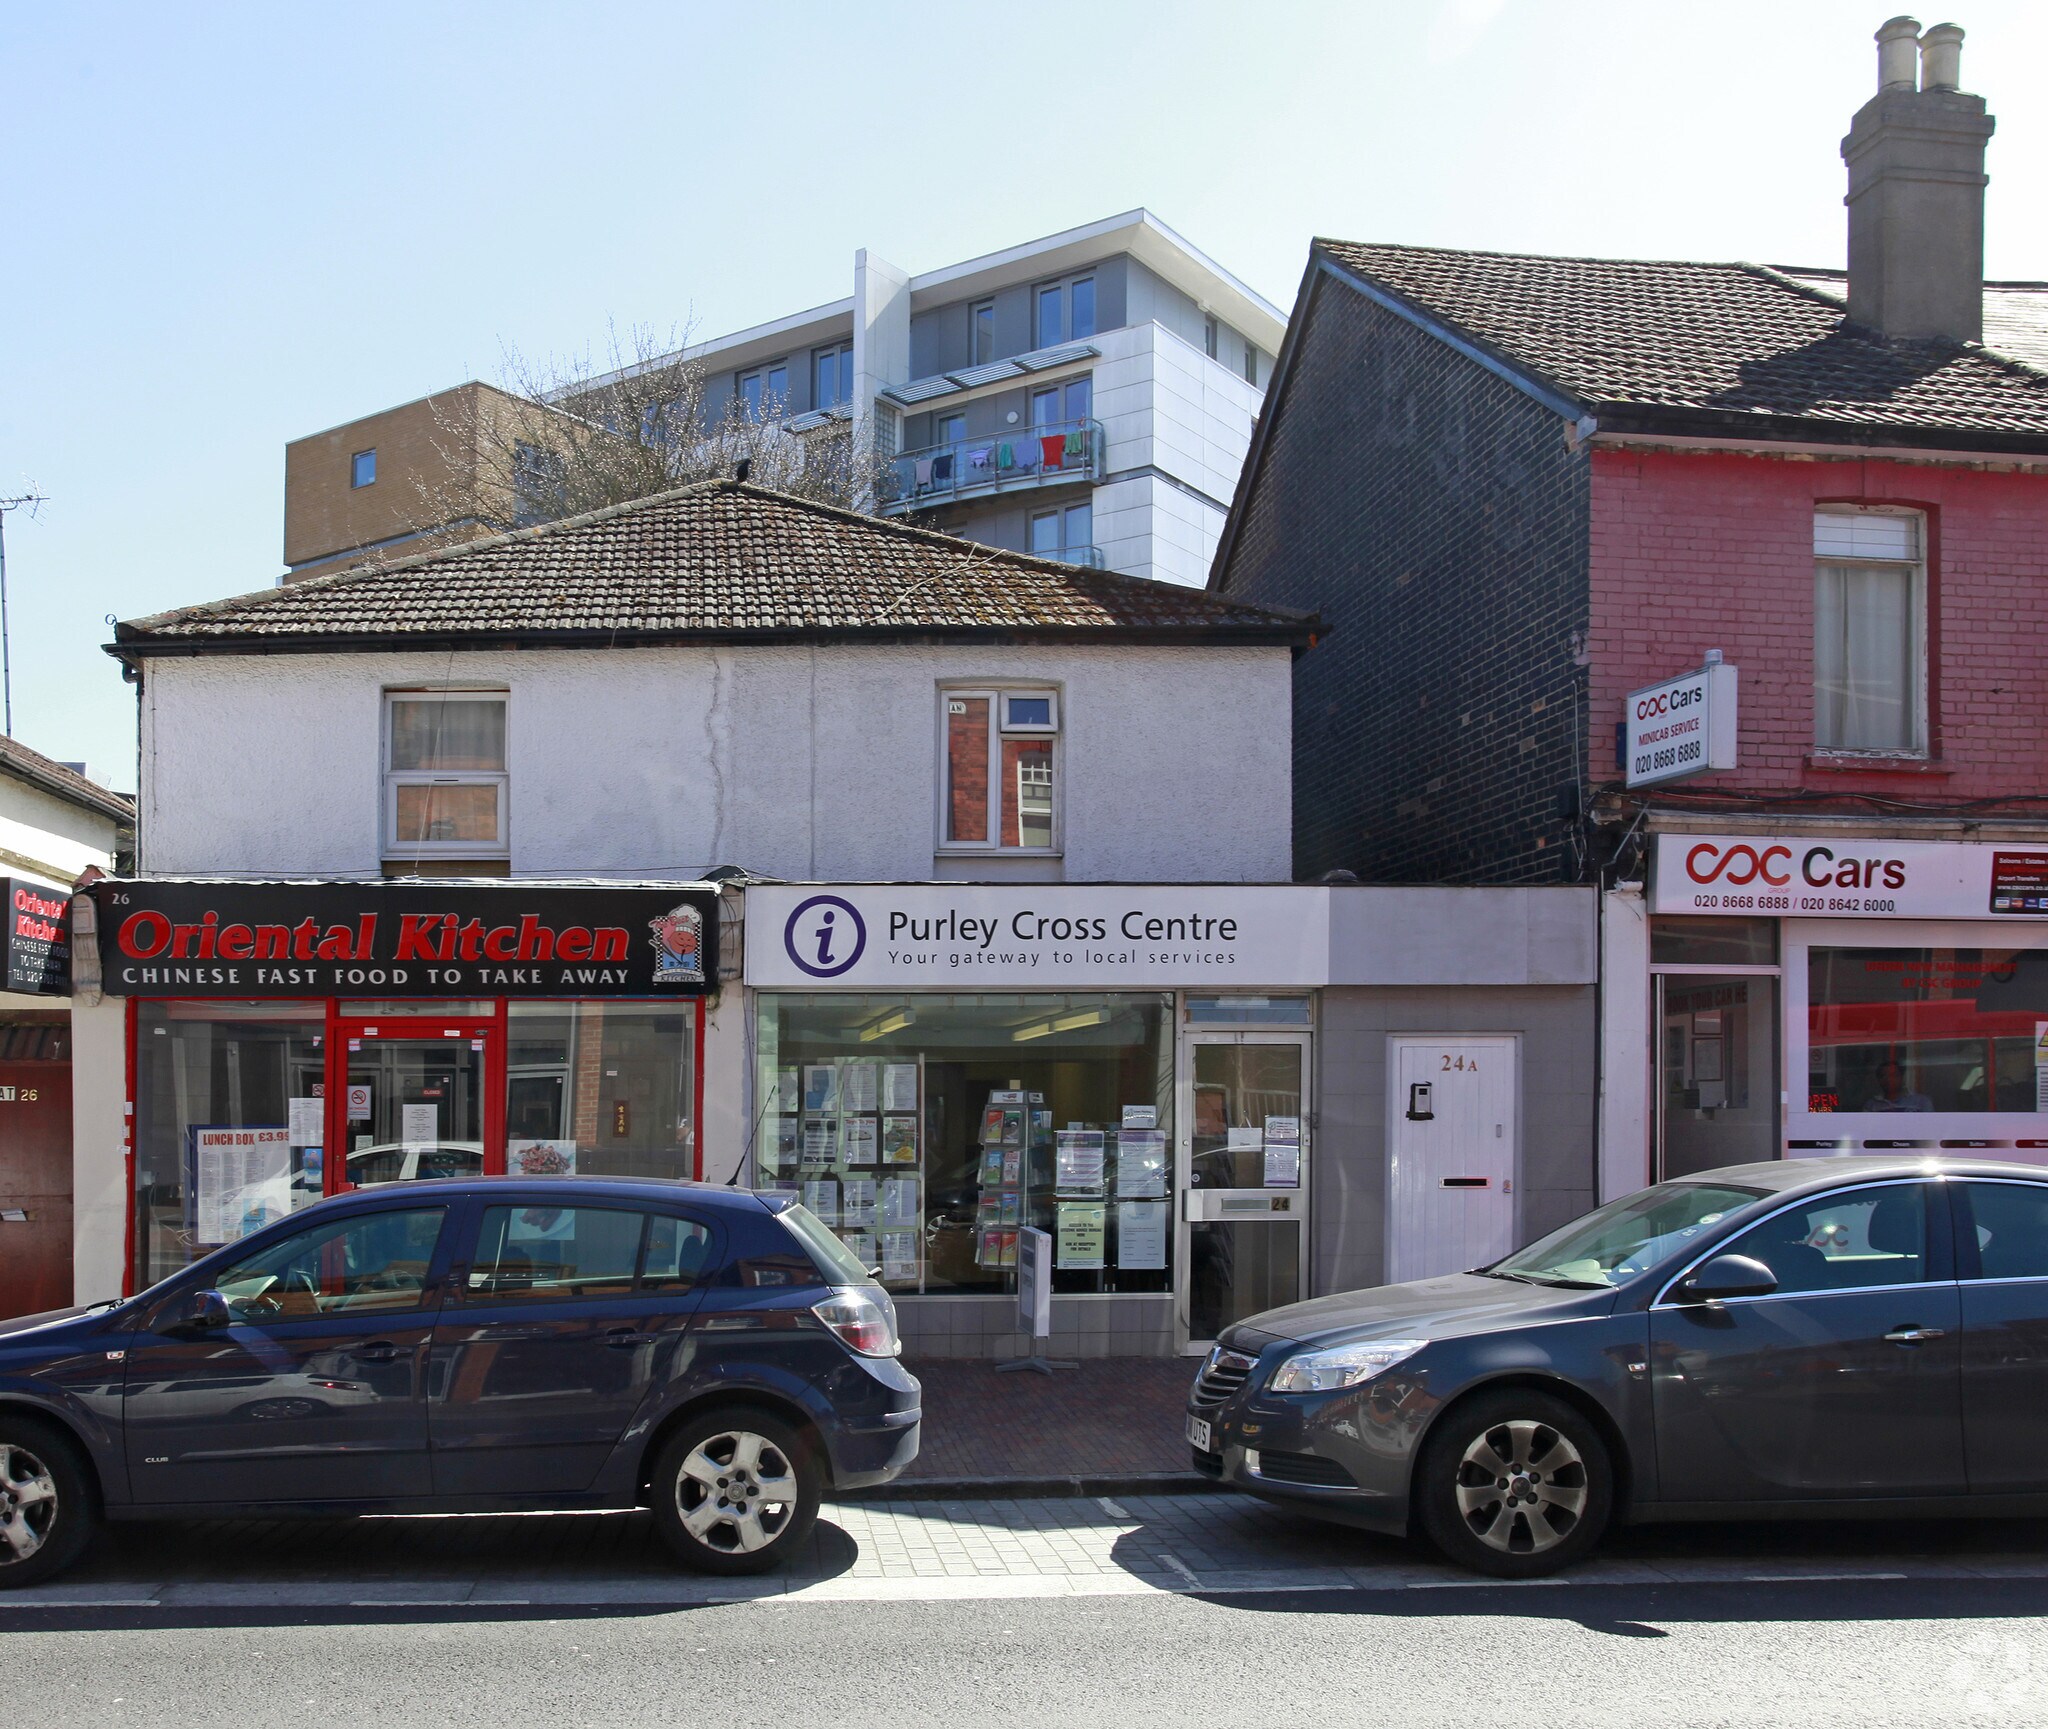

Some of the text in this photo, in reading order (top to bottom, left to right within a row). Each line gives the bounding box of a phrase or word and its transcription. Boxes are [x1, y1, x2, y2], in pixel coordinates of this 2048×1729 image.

[1670, 687, 1702, 710] Cars
[1638, 717, 1699, 746] MINICAB SERVICE
[1635, 740, 1700, 774] 020 8668 6888
[1802, 846, 1906, 889] Cars
[14, 888, 68, 920] Oriental
[112, 893, 130, 905] 26
[1694, 895, 1718, 907] 020
[1722, 896, 1754, 908] 8668
[1758, 896, 1789, 909] 6888
[1801, 897, 1825, 910] 020
[1829, 898, 1860, 911] 8642
[1864, 899, 1894, 912] 6000
[117, 910, 629, 961] Oriental Kitchen
[889, 909, 1237, 949] Purley Cross Centre
[888, 949, 1236, 967] Your gateway to local services
[123, 967, 628, 984] CHINESE FAST FOOD TO TAKE AWAY
[1715, 987, 1733, 1006] CAR
[21, 1089, 38, 1101] 26
[203, 1133, 233, 1146] LUNCH
[236, 1133, 255, 1146] BOX
[1272, 1197, 1289, 1211] 24
